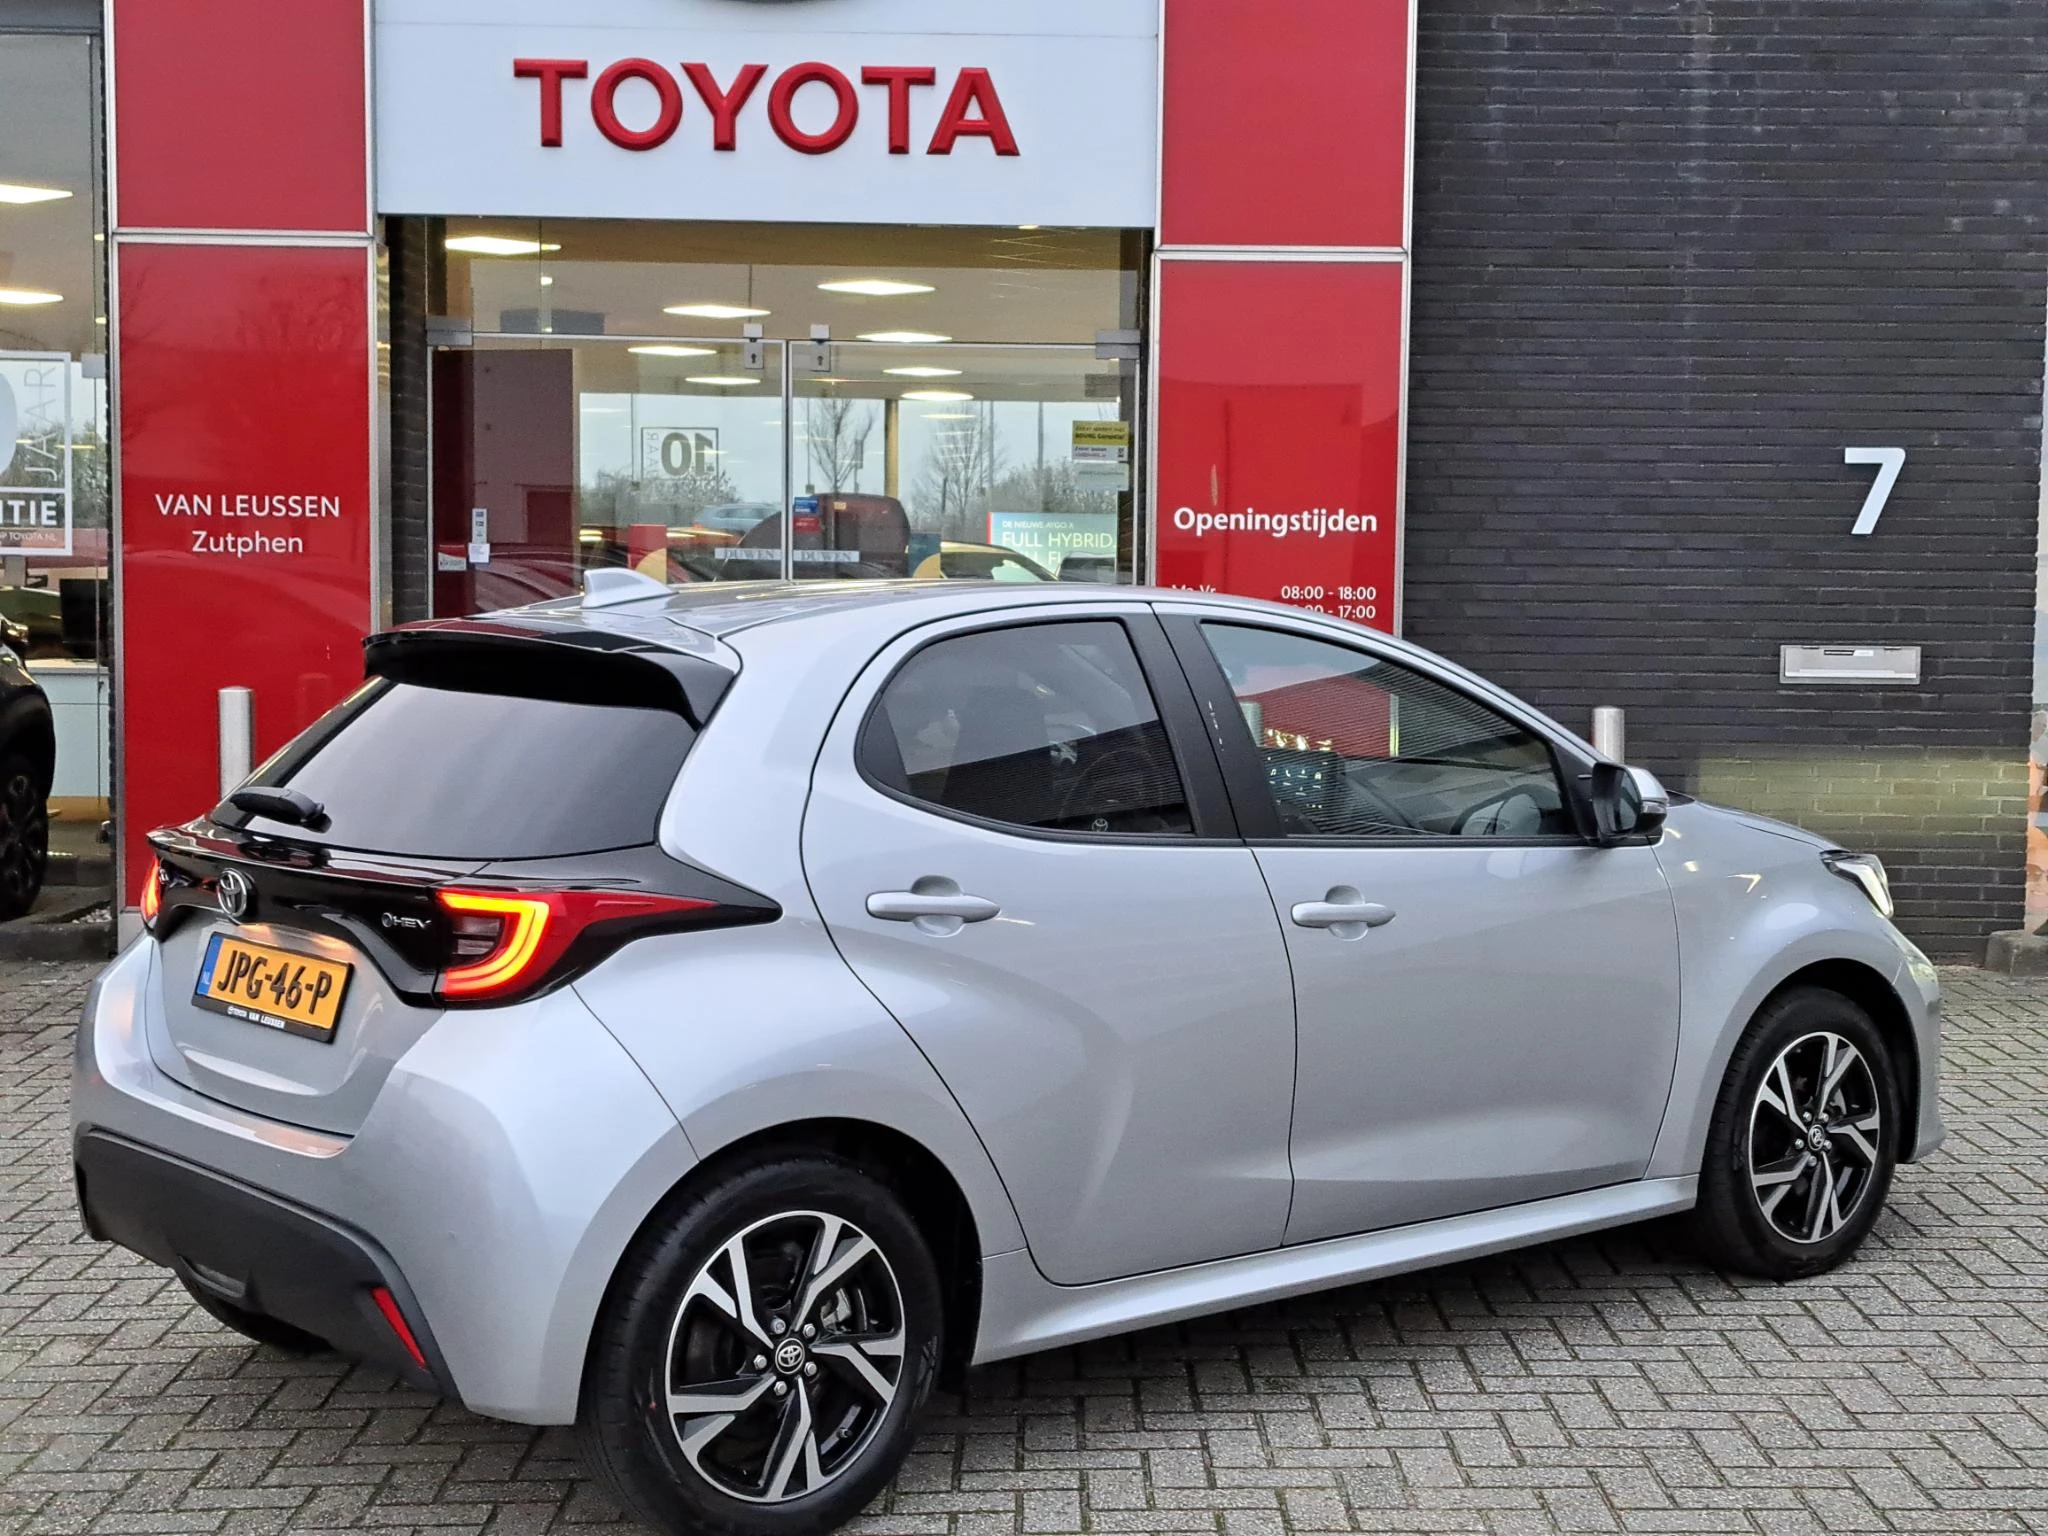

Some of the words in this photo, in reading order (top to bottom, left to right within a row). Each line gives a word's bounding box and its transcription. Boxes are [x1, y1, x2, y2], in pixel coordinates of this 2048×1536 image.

[513, 57, 1020, 157] TOYOTA
[23, 366, 58, 482] JAAR
[1844, 447, 1906, 535] 7
[0, 500, 57, 526] TIE
[155, 494, 212, 516] VAN
[221, 495, 340, 517] LEUSSEN
[1014, 521, 1043, 529] NIEUWE
[1173, 506, 1377, 538] Openingstijden
[191, 530, 303, 558] Zutphen
[1002, 531, 1042, 548] FULL
[1281, 585, 1324, 600] 08:00
[1338, 586, 1377, 601] 18:00
[1338, 605, 1377, 619] 17:00
[217, 950, 332, 1015] JPG-46-P
